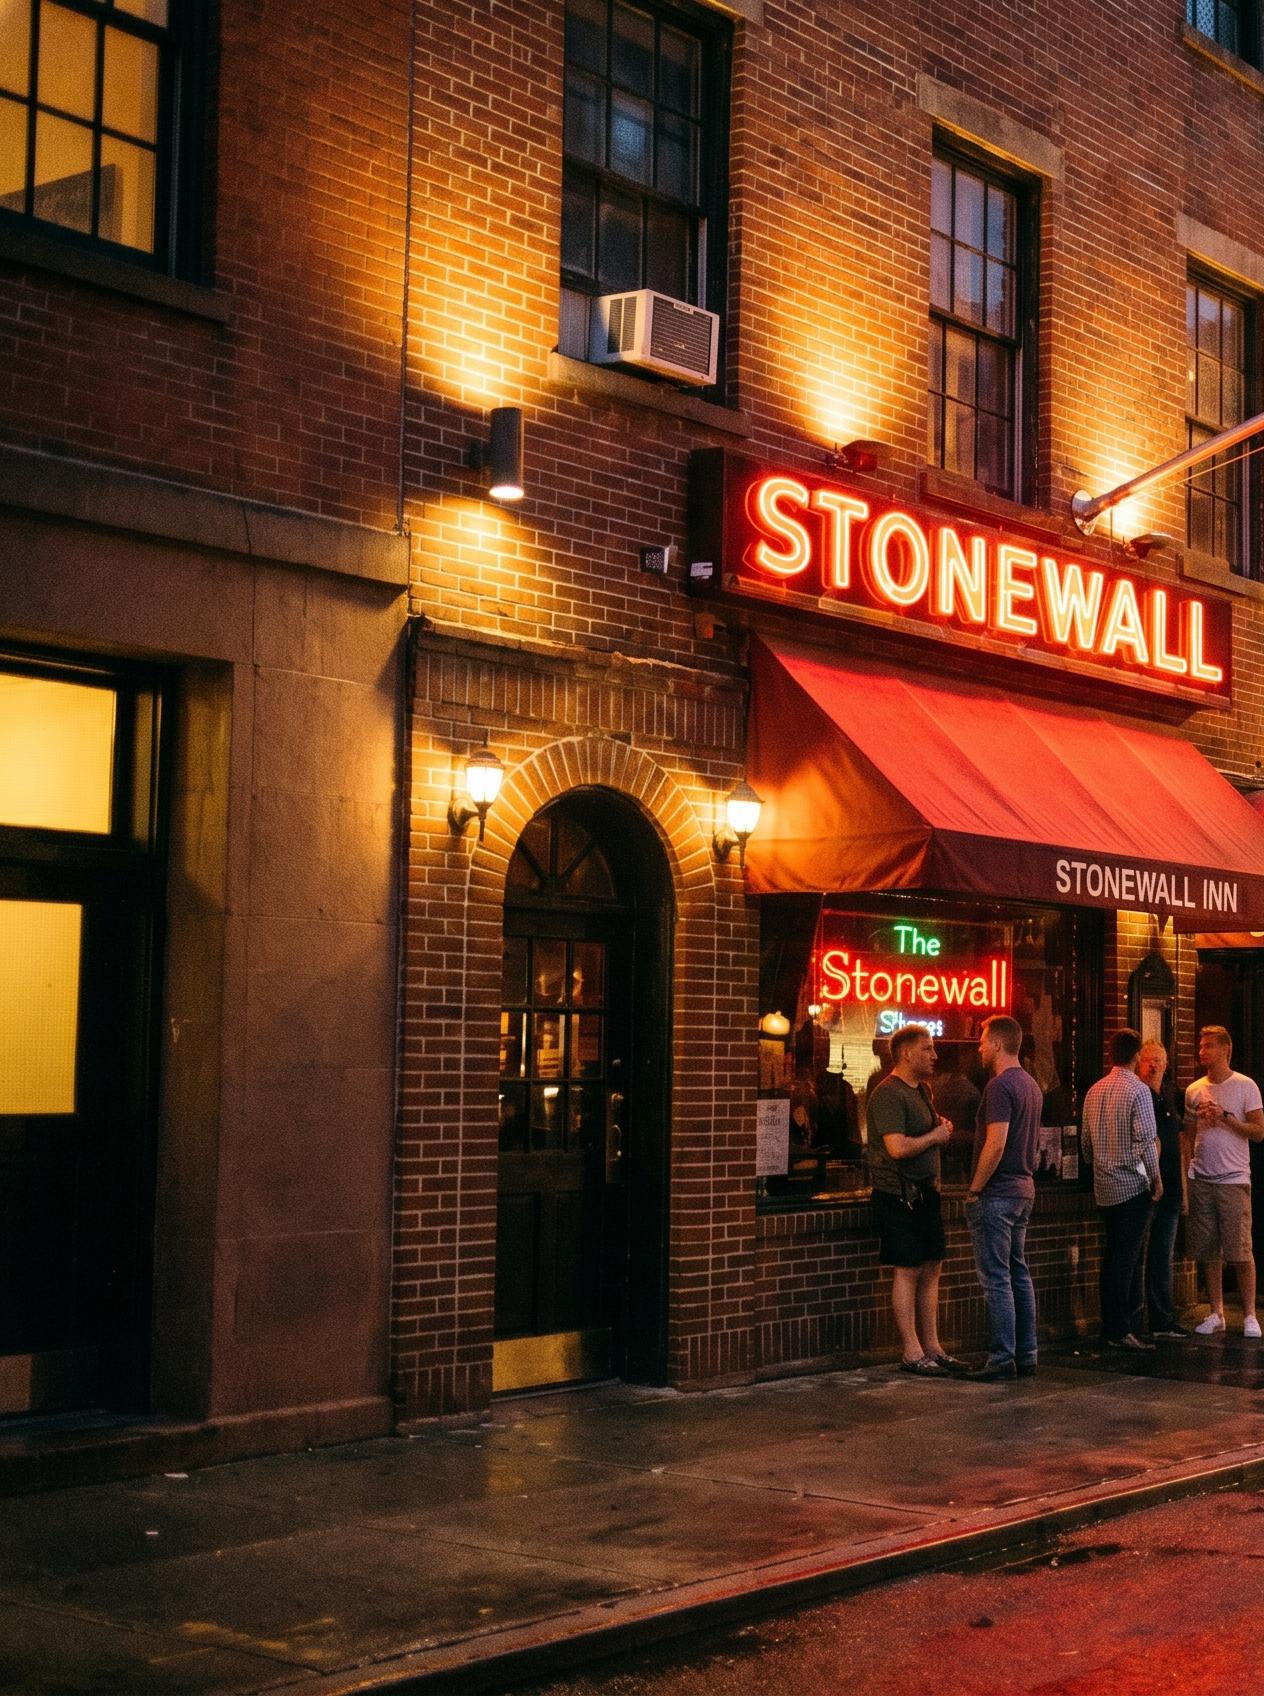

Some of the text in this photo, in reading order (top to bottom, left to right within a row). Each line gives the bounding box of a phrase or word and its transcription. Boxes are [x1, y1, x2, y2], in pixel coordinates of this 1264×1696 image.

[754, 476, 1224, 683] STONEWALL
[1055, 859, 1238, 913] STONEWALL INN
[893, 925, 941, 956] The
[821, 950, 1007, 1008] Stonewall
